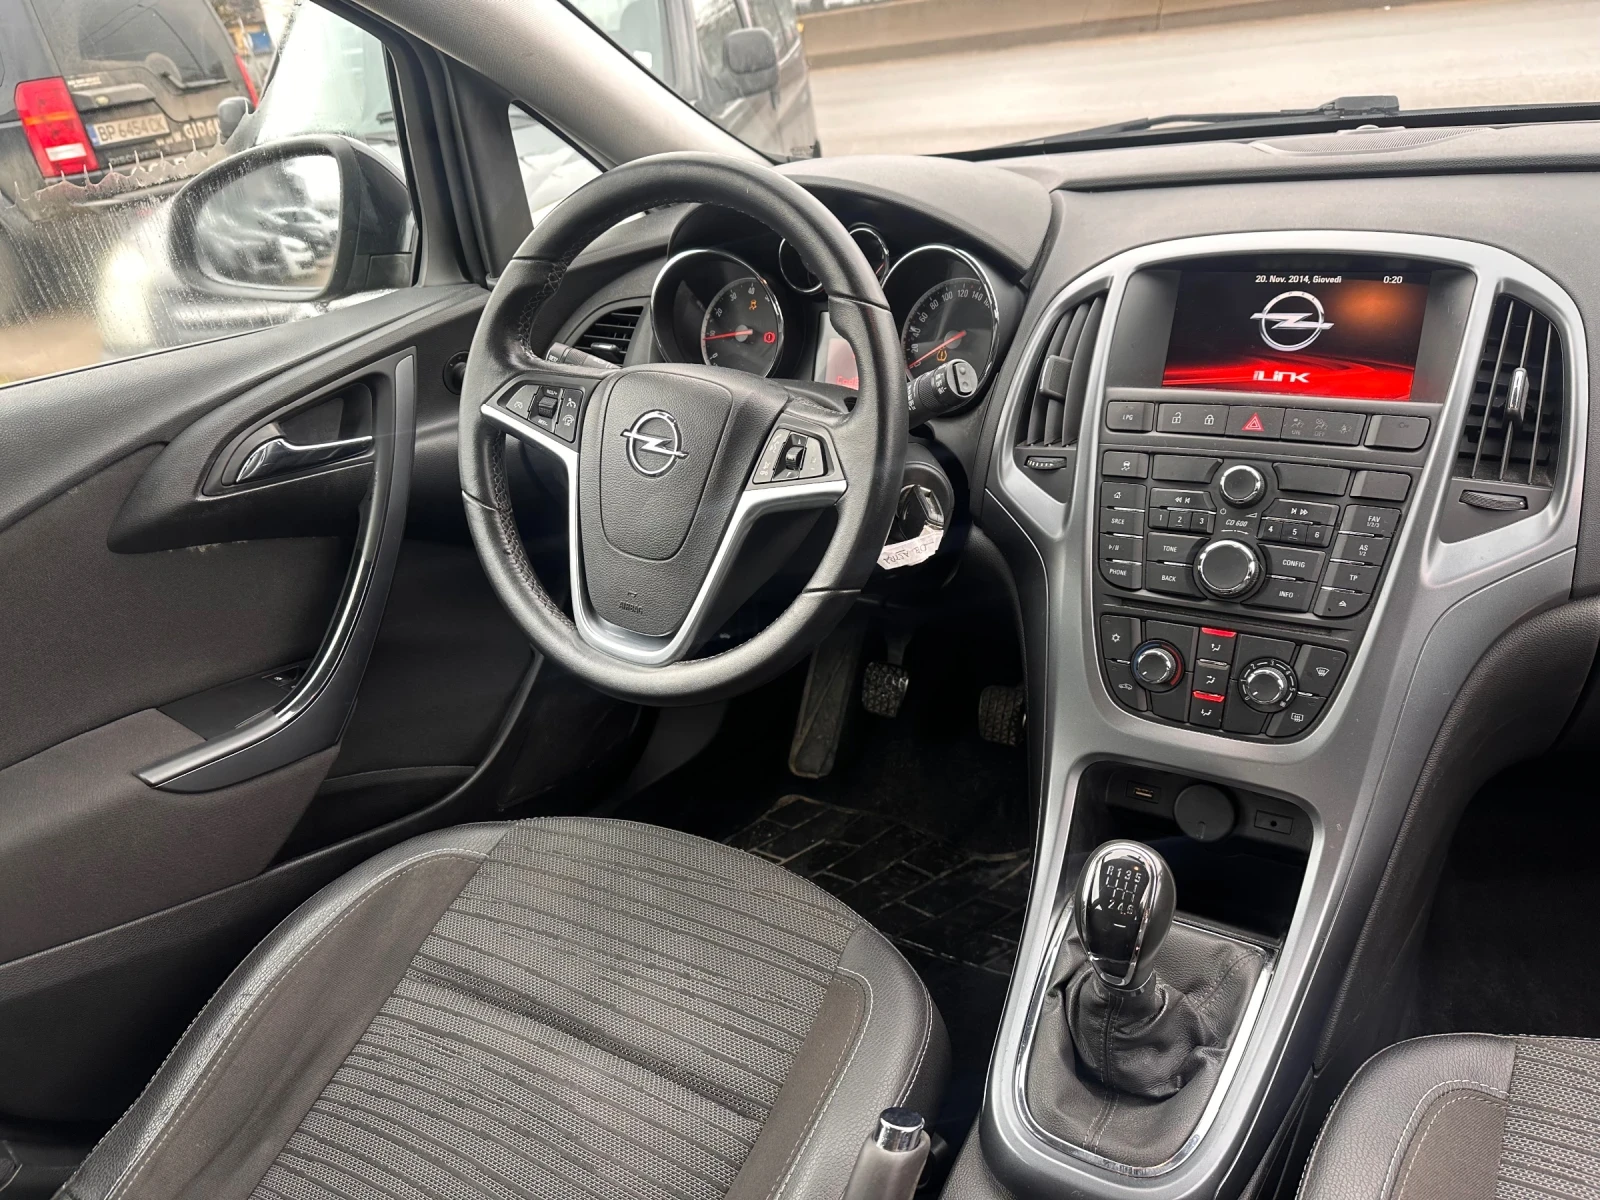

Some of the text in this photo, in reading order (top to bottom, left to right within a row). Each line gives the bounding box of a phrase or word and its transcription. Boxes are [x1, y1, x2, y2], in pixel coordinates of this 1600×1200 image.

[1255, 274, 1268, 283] 20.
[1269, 274, 1287, 283] Nov.
[1288, 274, 1311, 284] 2014,
[1383, 275, 1403, 284] 0:20
[941, 291, 953, 302] 100
[957, 289, 969, 298] 120
[971, 290, 984, 301] 140
[929, 299, 939, 310] 80
[918, 312, 929, 323] 60
[911, 343, 919, 353] 20
[1110, 517, 1125, 525] SRCE
[1163, 545, 1178, 553] TONE
[1282, 559, 1306, 568] CONFIG
[1109, 568, 1127, 576] PHONE
[1161, 574, 1177, 582] BACK
[1279, 590, 1294, 598] INFO
[1106, 865, 1114, 875] R
[1124, 869, 1132, 880] 3
[1134, 872, 1142, 883] 5
[1107, 899, 1115, 909] 2
